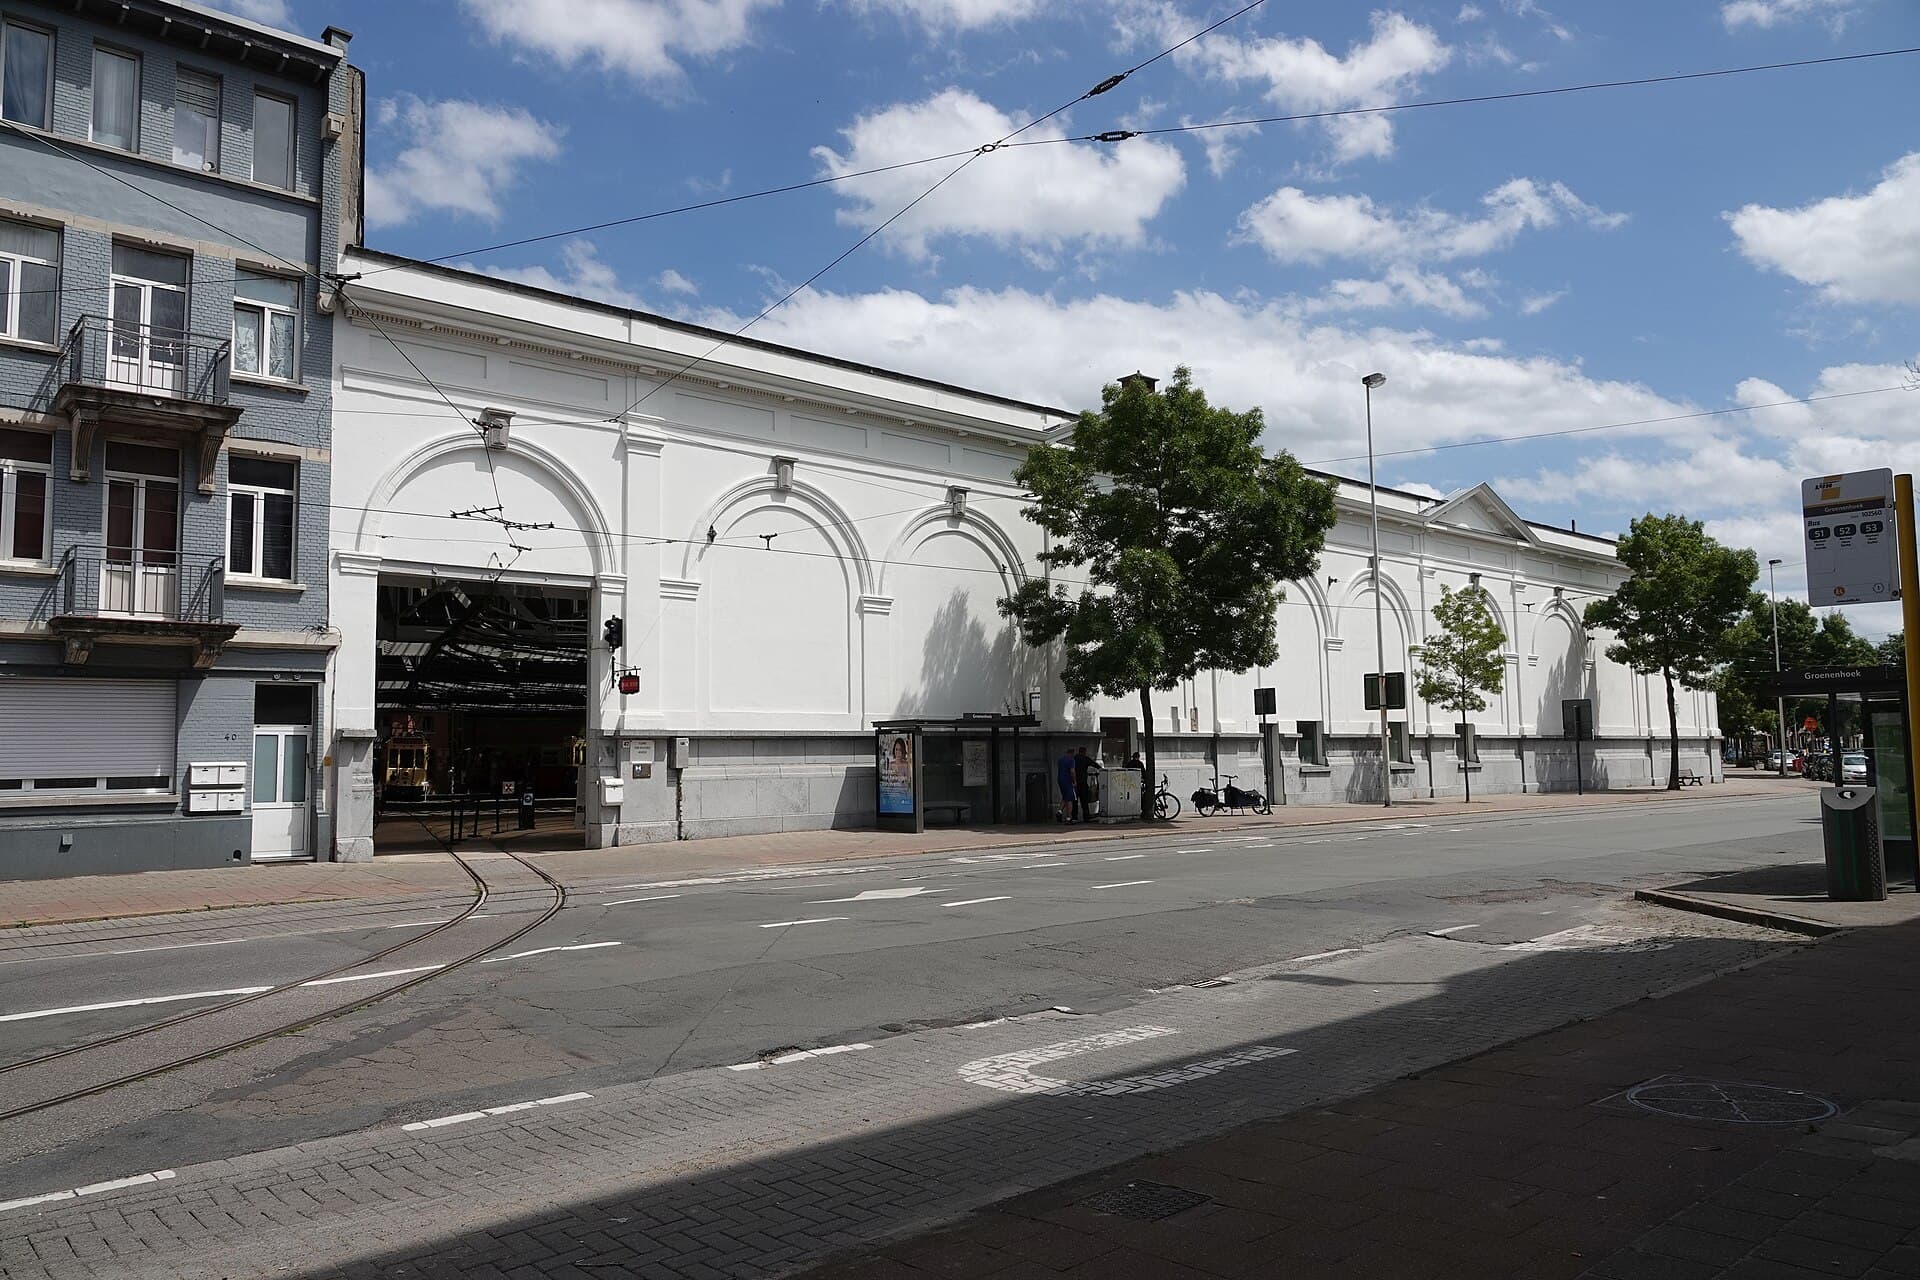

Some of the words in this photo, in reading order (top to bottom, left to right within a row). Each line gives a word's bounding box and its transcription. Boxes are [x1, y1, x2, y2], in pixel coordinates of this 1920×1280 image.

[1839, 526, 1851, 536] 52
[1865, 523, 1878, 532] 53
[1814, 530, 1824, 538] 51
[1804, 670, 1861, 679] Groenenhoek
